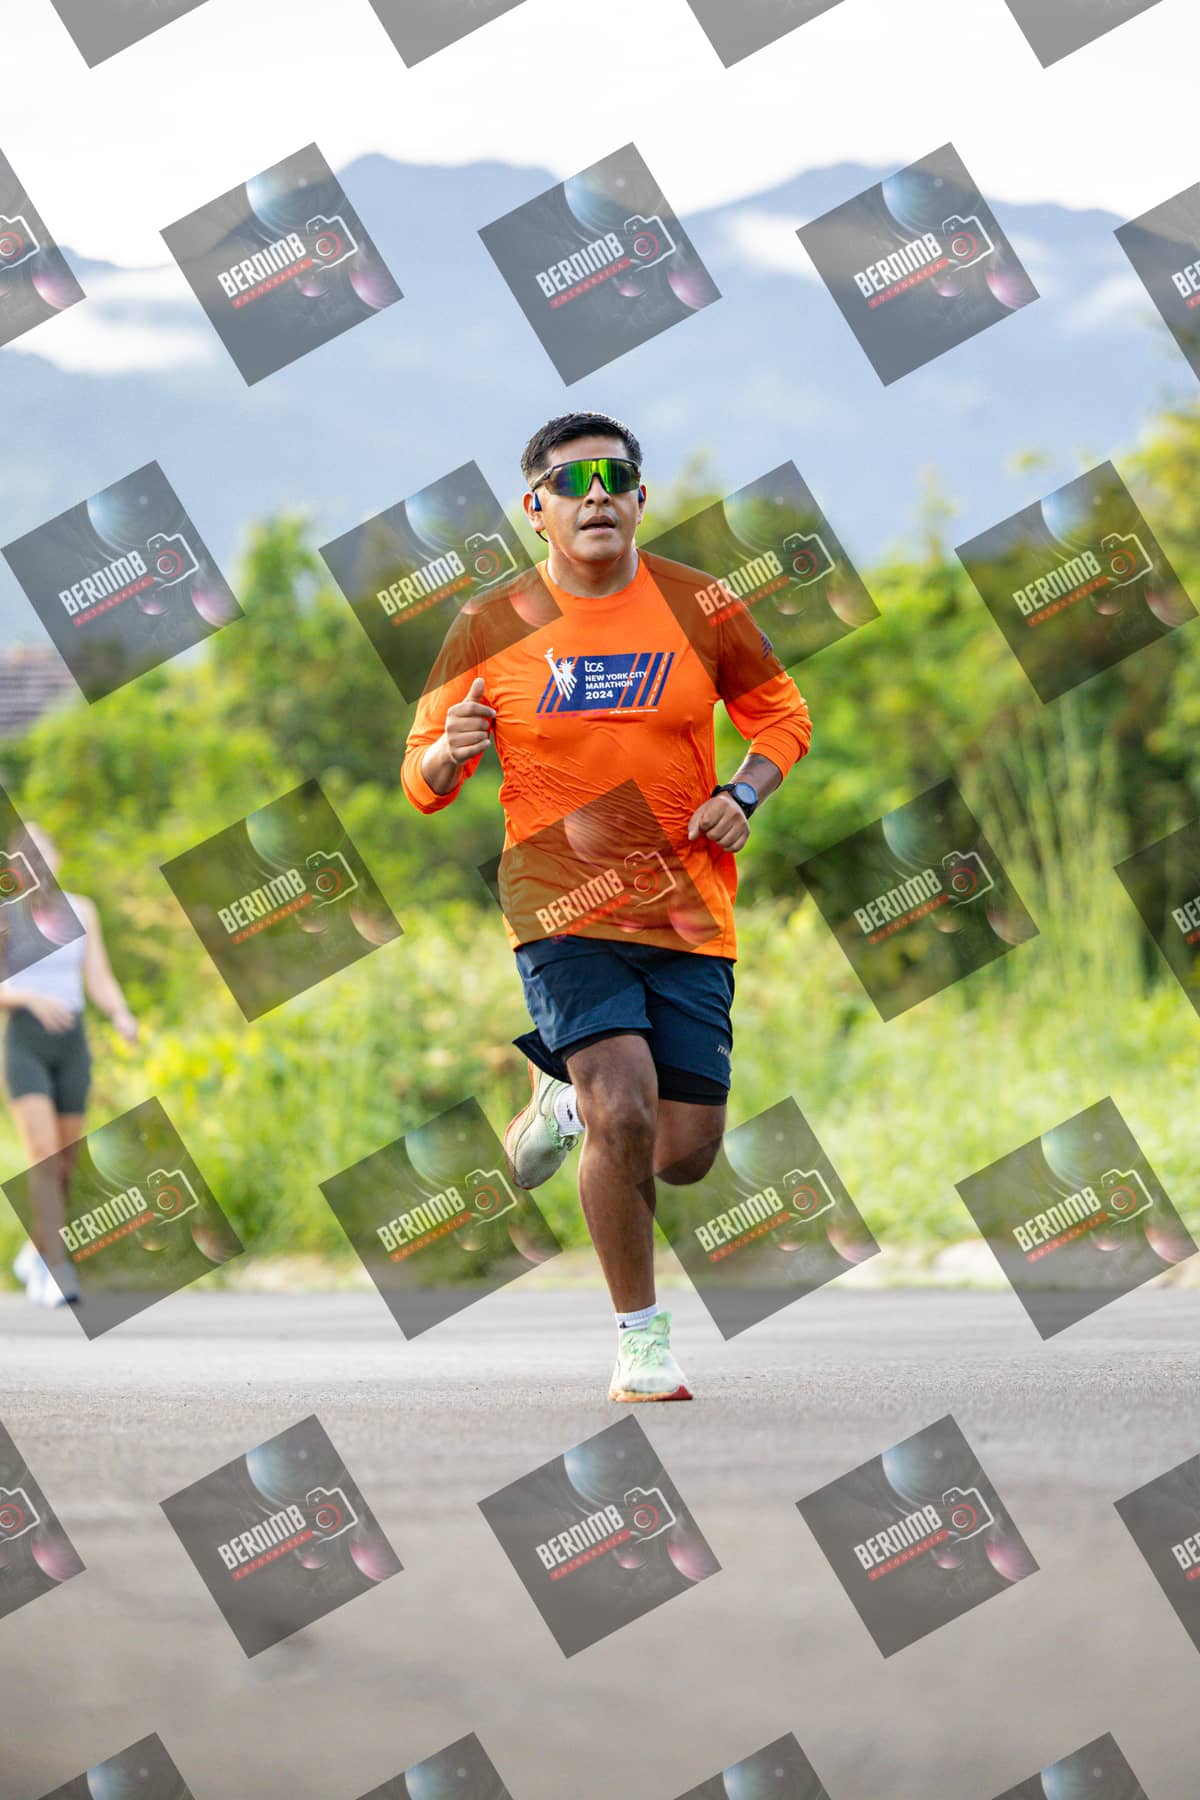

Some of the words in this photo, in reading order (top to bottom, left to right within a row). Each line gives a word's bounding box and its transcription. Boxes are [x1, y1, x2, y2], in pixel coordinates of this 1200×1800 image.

[585, 674, 605, 682] NEW
[606, 672, 628, 680] YORK
[629, 671, 648, 679] CITY
[585, 680, 634, 690] MARATHON
[585, 690, 614, 700] 2024
